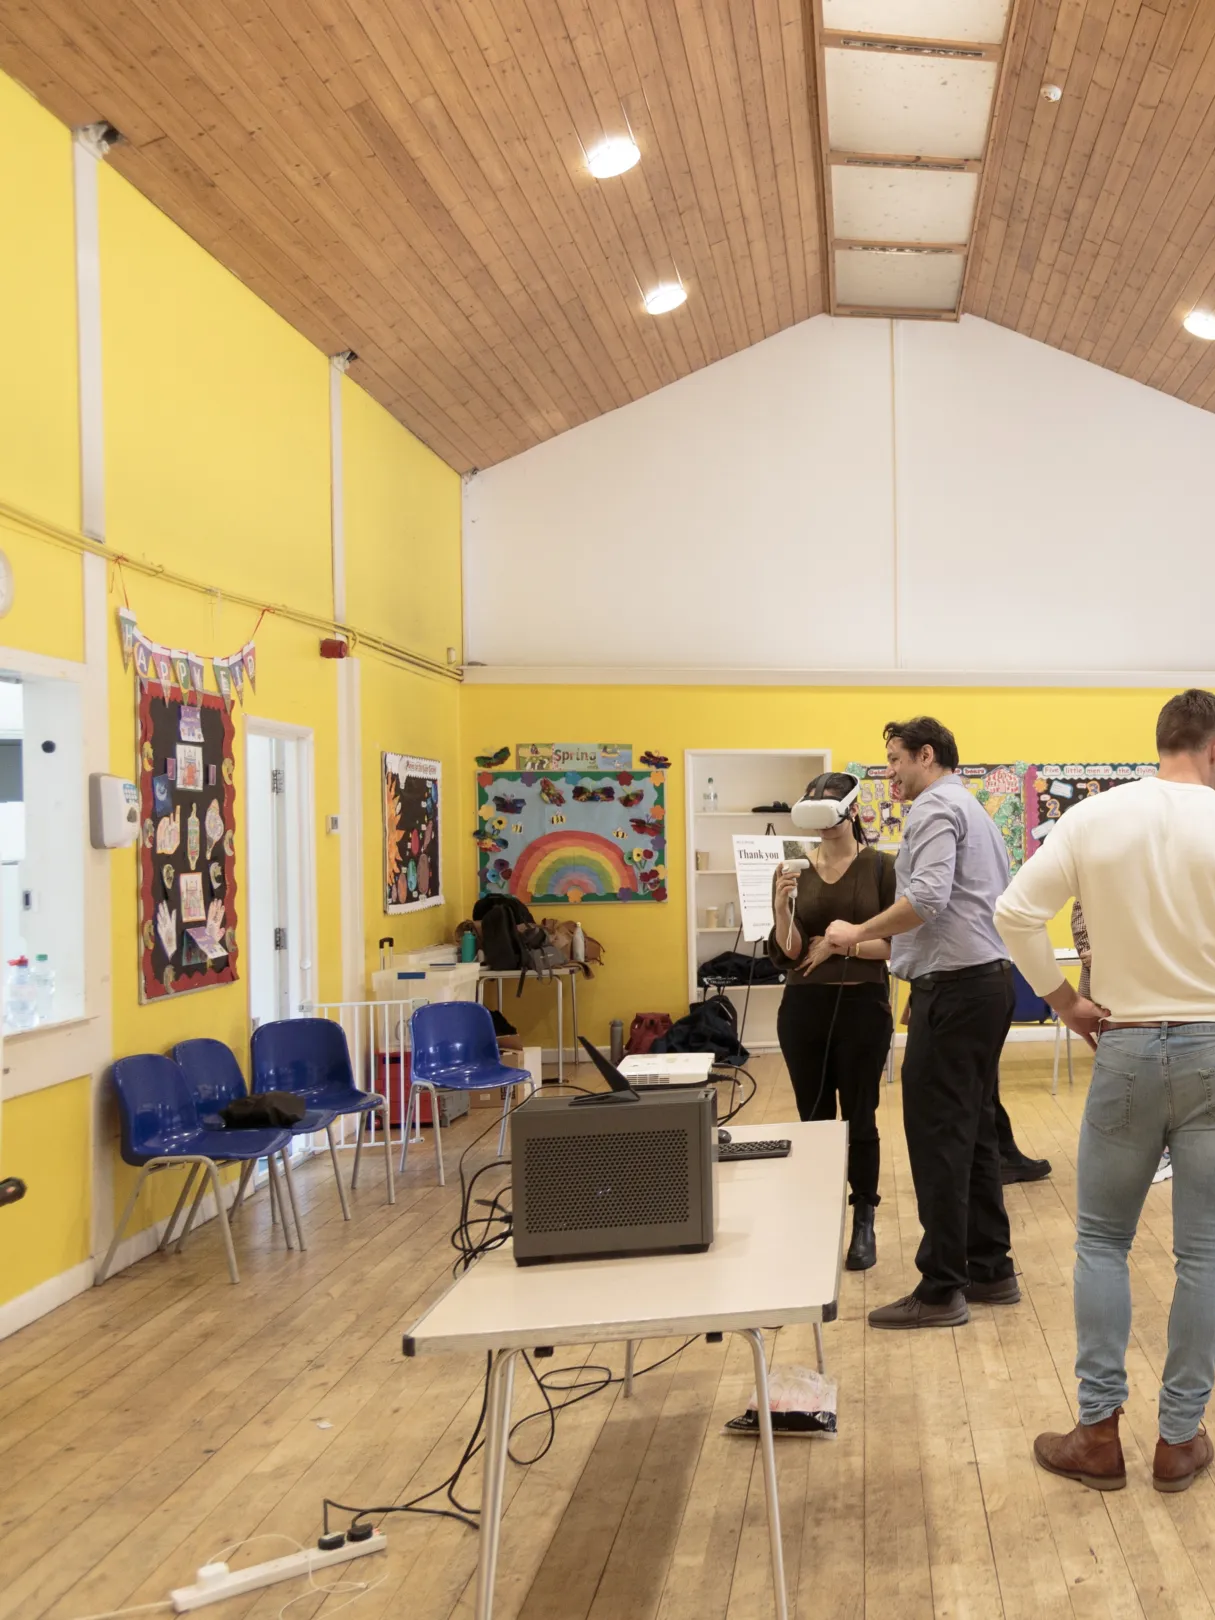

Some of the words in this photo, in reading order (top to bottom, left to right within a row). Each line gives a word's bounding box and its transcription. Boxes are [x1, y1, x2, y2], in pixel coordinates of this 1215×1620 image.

[124, 623, 202, 689] HAPPY
[219, 655, 255, 696] EID
[554, 748, 597, 765] Spring
[1065, 766, 1083, 774] little
[1103, 766, 1111, 774] in
[1136, 766, 1156, 775] flying
[1047, 798, 1060, 818] 2
[738, 849, 764, 860] Thank
[765, 852, 780, 861] you
